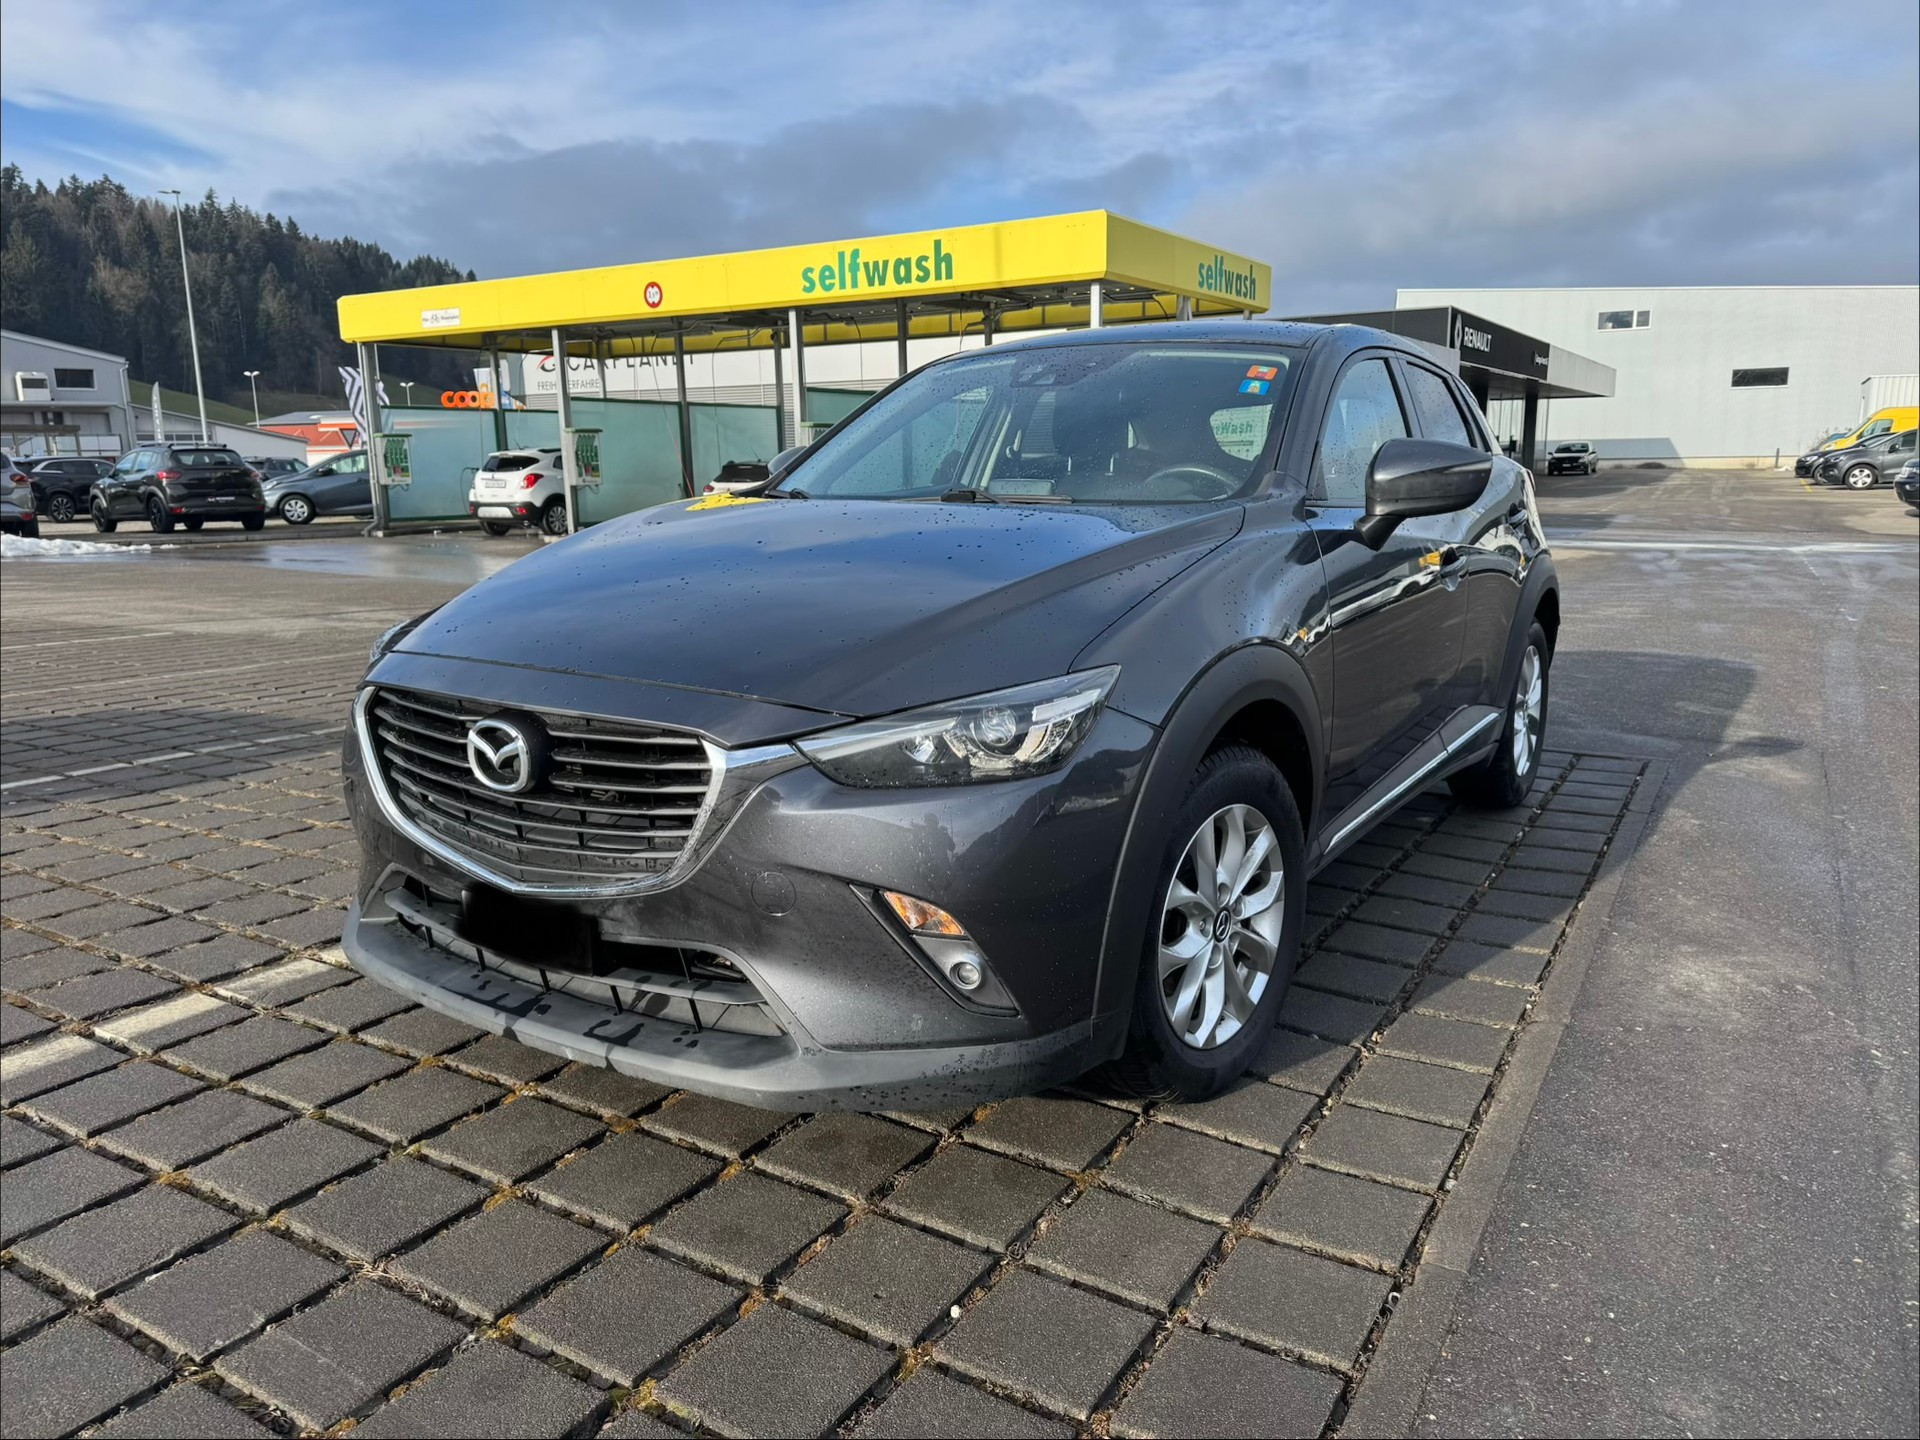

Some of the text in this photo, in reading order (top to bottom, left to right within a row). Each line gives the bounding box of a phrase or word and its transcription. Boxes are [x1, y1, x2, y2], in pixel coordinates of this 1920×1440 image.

[801, 239, 953, 294] selfwash
[1198, 254, 1256, 301] selfwash
[1463, 326, 1492, 352] RENAULT
[441, 390, 495, 409] coop
